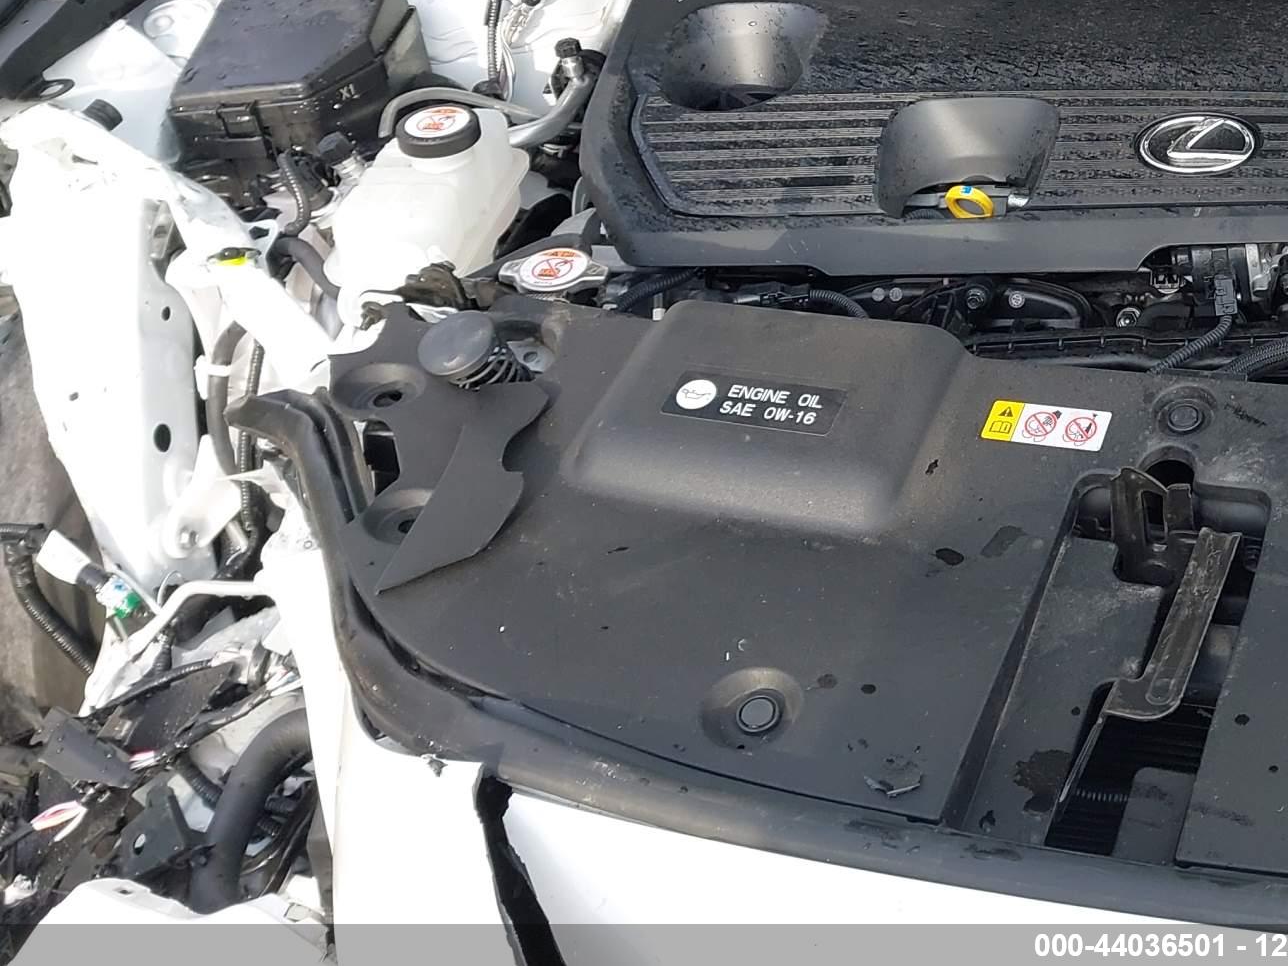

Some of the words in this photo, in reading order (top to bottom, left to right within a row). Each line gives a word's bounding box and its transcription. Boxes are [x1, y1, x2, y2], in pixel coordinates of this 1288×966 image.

[727, 384, 791, 404] ENGINE
[797, 393, 823, 409] OIL
[719, 400, 756, 418] SAE
